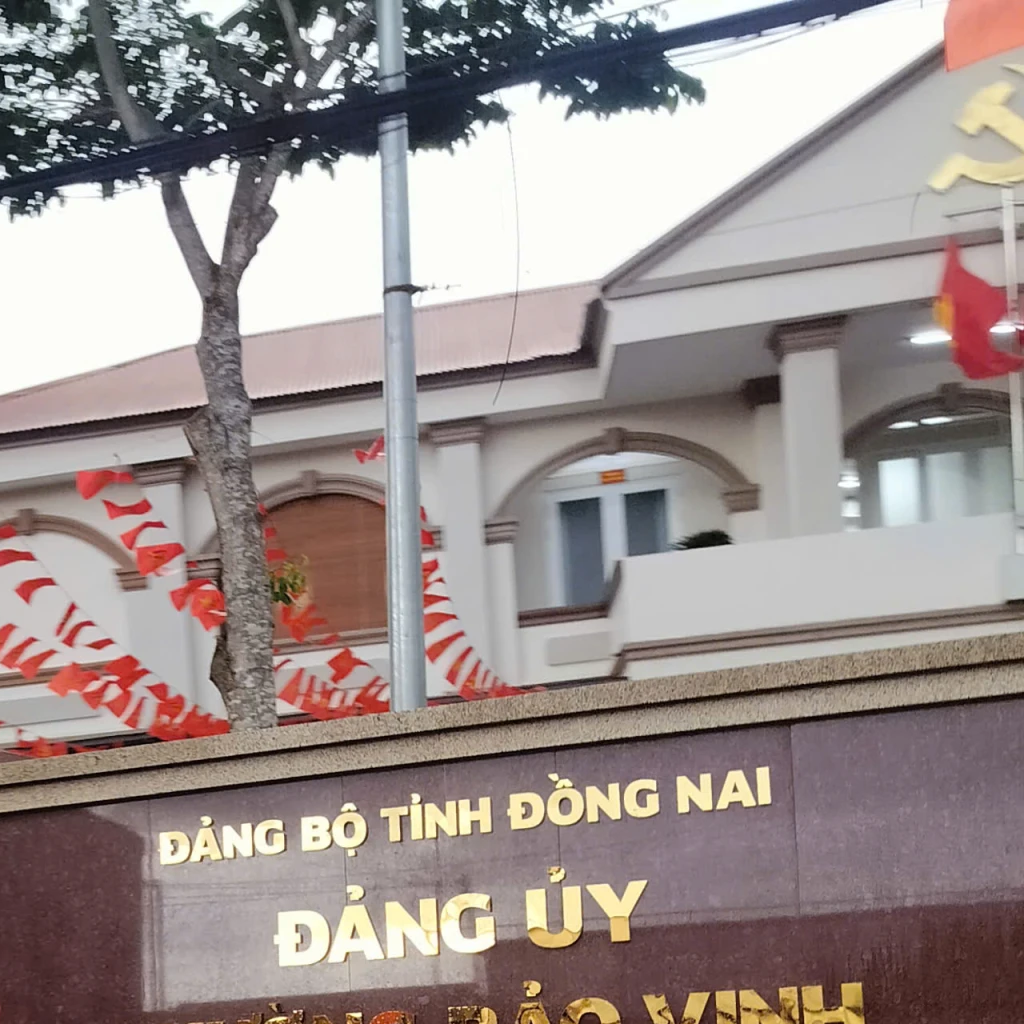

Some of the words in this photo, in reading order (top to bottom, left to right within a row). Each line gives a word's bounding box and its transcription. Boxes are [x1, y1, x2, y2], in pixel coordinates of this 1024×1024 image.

[158, 816, 286, 865] ĐẢNG
[301, 803, 368, 857] BỘ
[380, 793, 492, 842] TỈNH
[507, 773, 660, 830] ĐỒNG
[676, 766, 772, 814] NAI
[274, 885, 496, 967] ĐẢNG
[526, 866, 647, 948] ỦY
